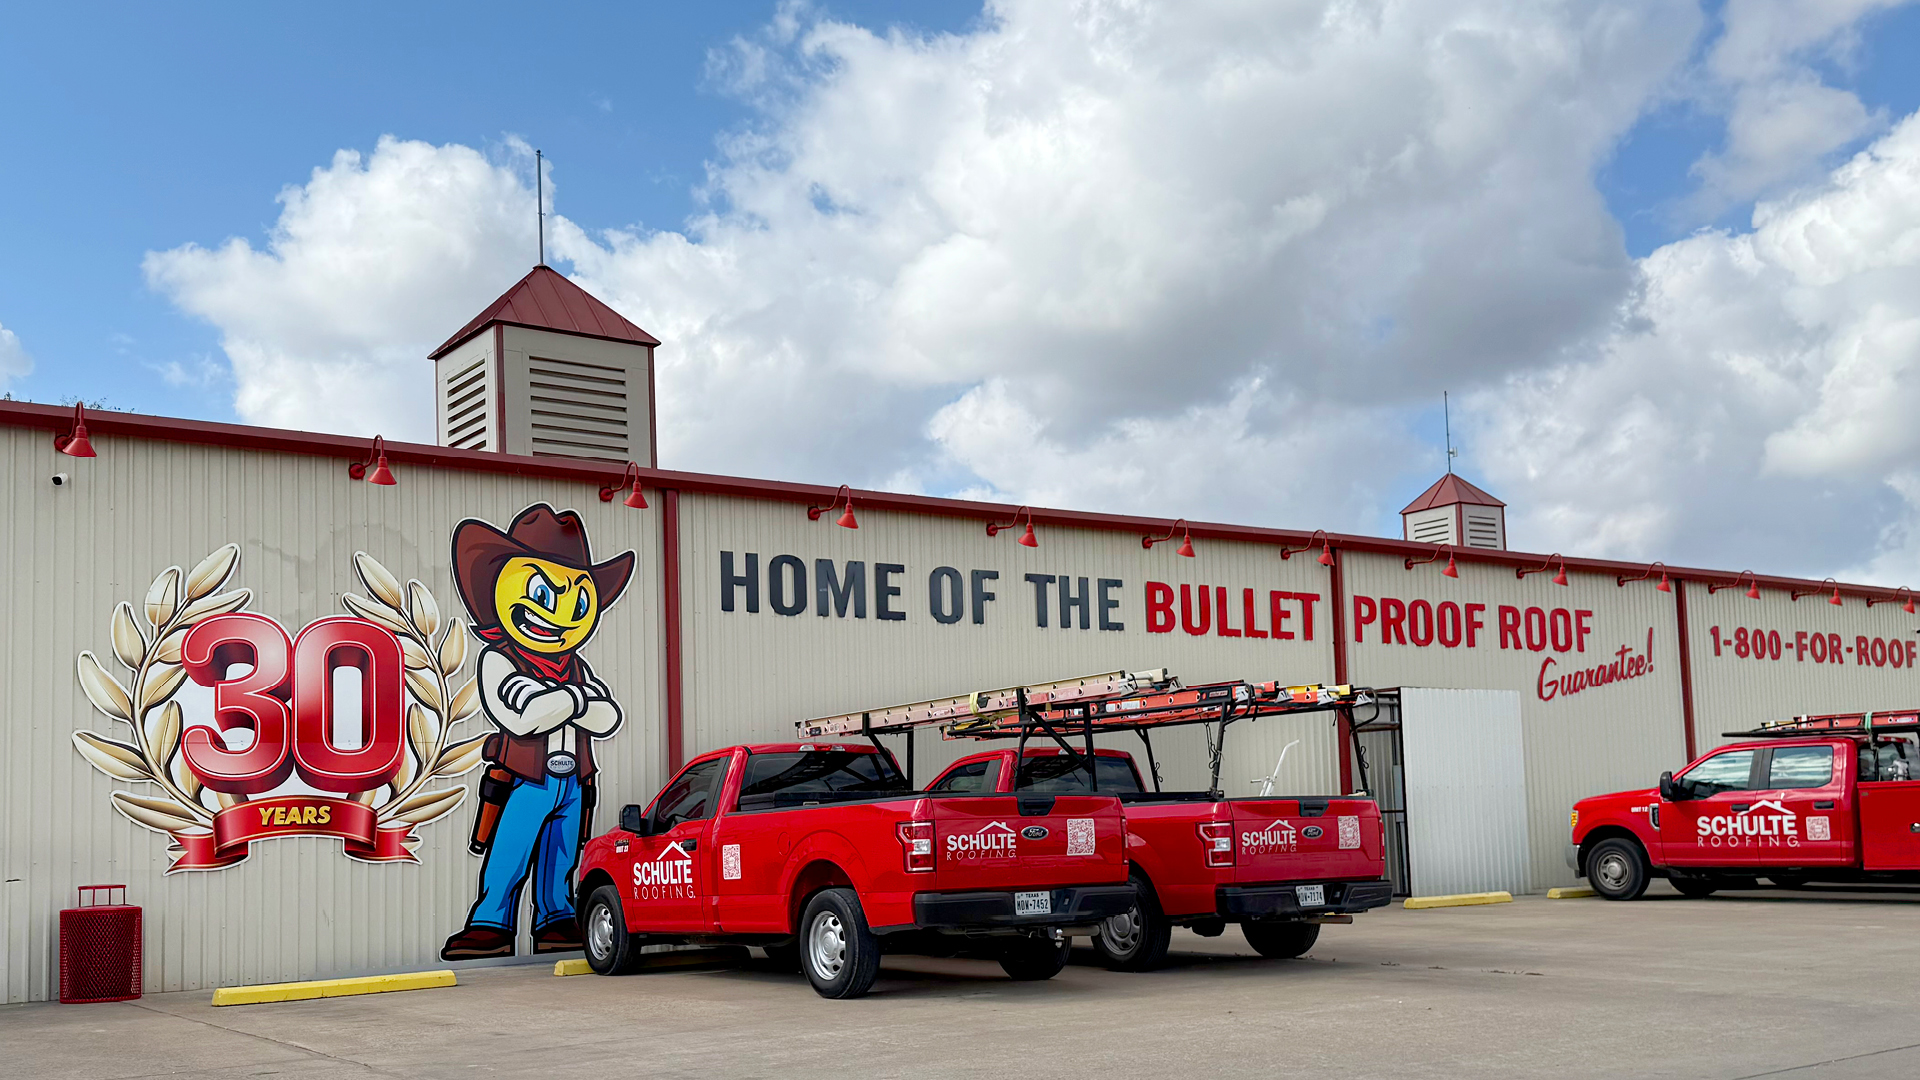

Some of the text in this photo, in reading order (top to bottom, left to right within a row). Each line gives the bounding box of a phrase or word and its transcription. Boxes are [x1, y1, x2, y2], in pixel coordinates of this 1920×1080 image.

[720, 550, 1593, 652] HOME OF THE BULLET PROOF ROOF
[1710, 625, 1917, 669] 1-800-FOR-ROOF
[1537, 626, 1654, 701] Guarantee!
[181, 612, 405, 794] 30
[258, 806, 331, 826] YEARS
[1697, 815, 1798, 836] SCHULTE
[947, 833, 1017, 851] SCHULTE
[1242, 830, 1297, 847] SCHULTE
[1698, 835, 1800, 848] ROOFING
[947, 849, 1017, 860] ROOFING
[1242, 844, 1297, 855] ROOFING
[633, 859, 693, 886] SCHULTE
